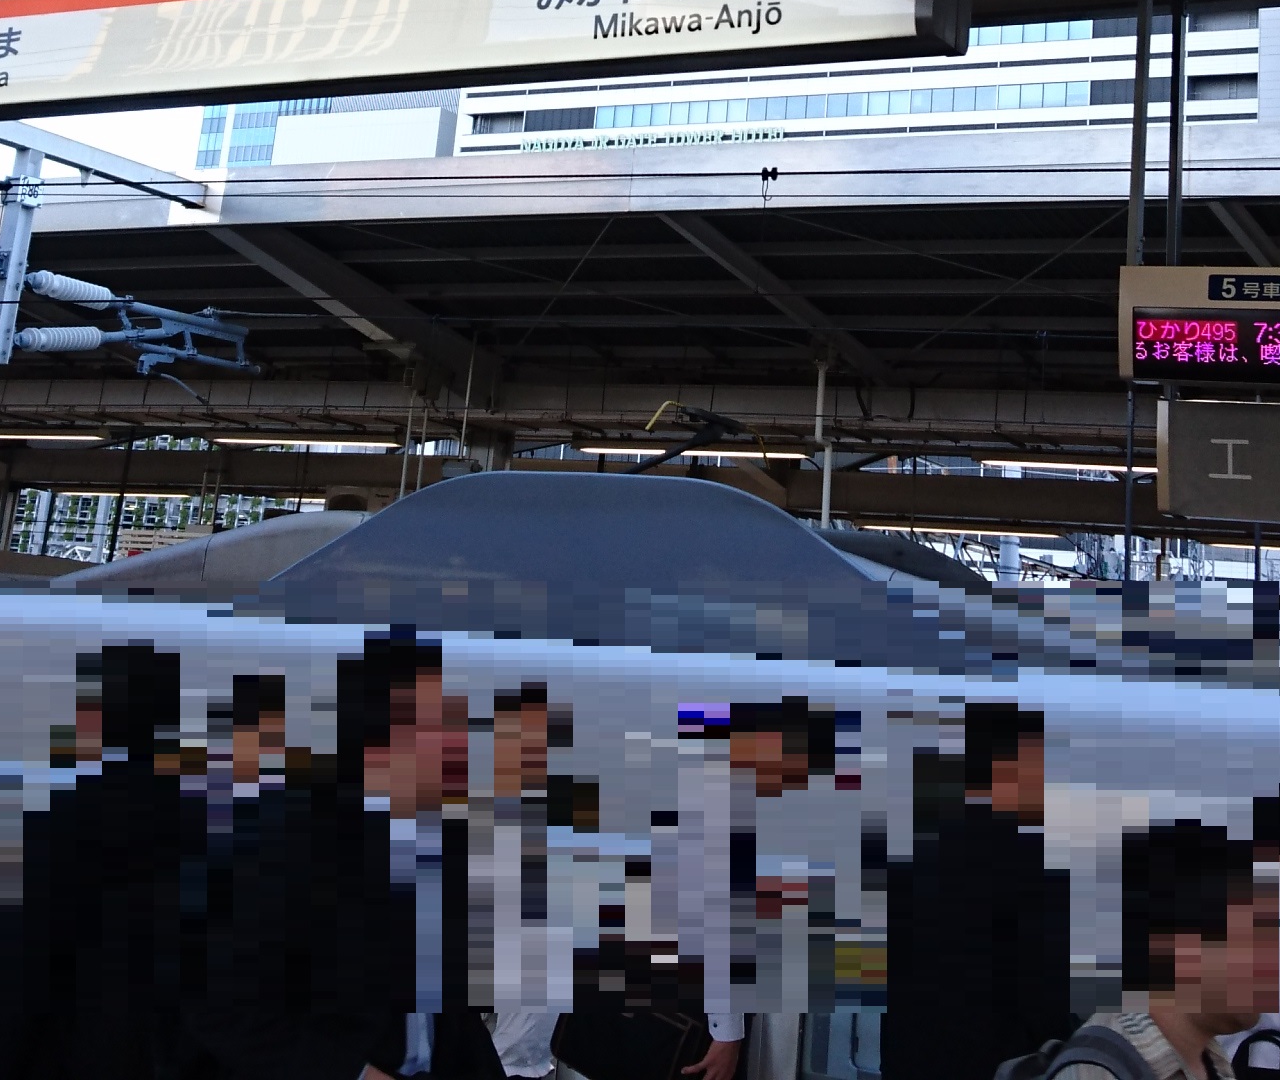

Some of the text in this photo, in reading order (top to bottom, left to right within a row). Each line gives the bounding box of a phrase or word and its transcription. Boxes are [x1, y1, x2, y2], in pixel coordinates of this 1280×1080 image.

[1221, 277, 1280, 299] 5号車
[1136, 321, 1236, 341] ひかり495
